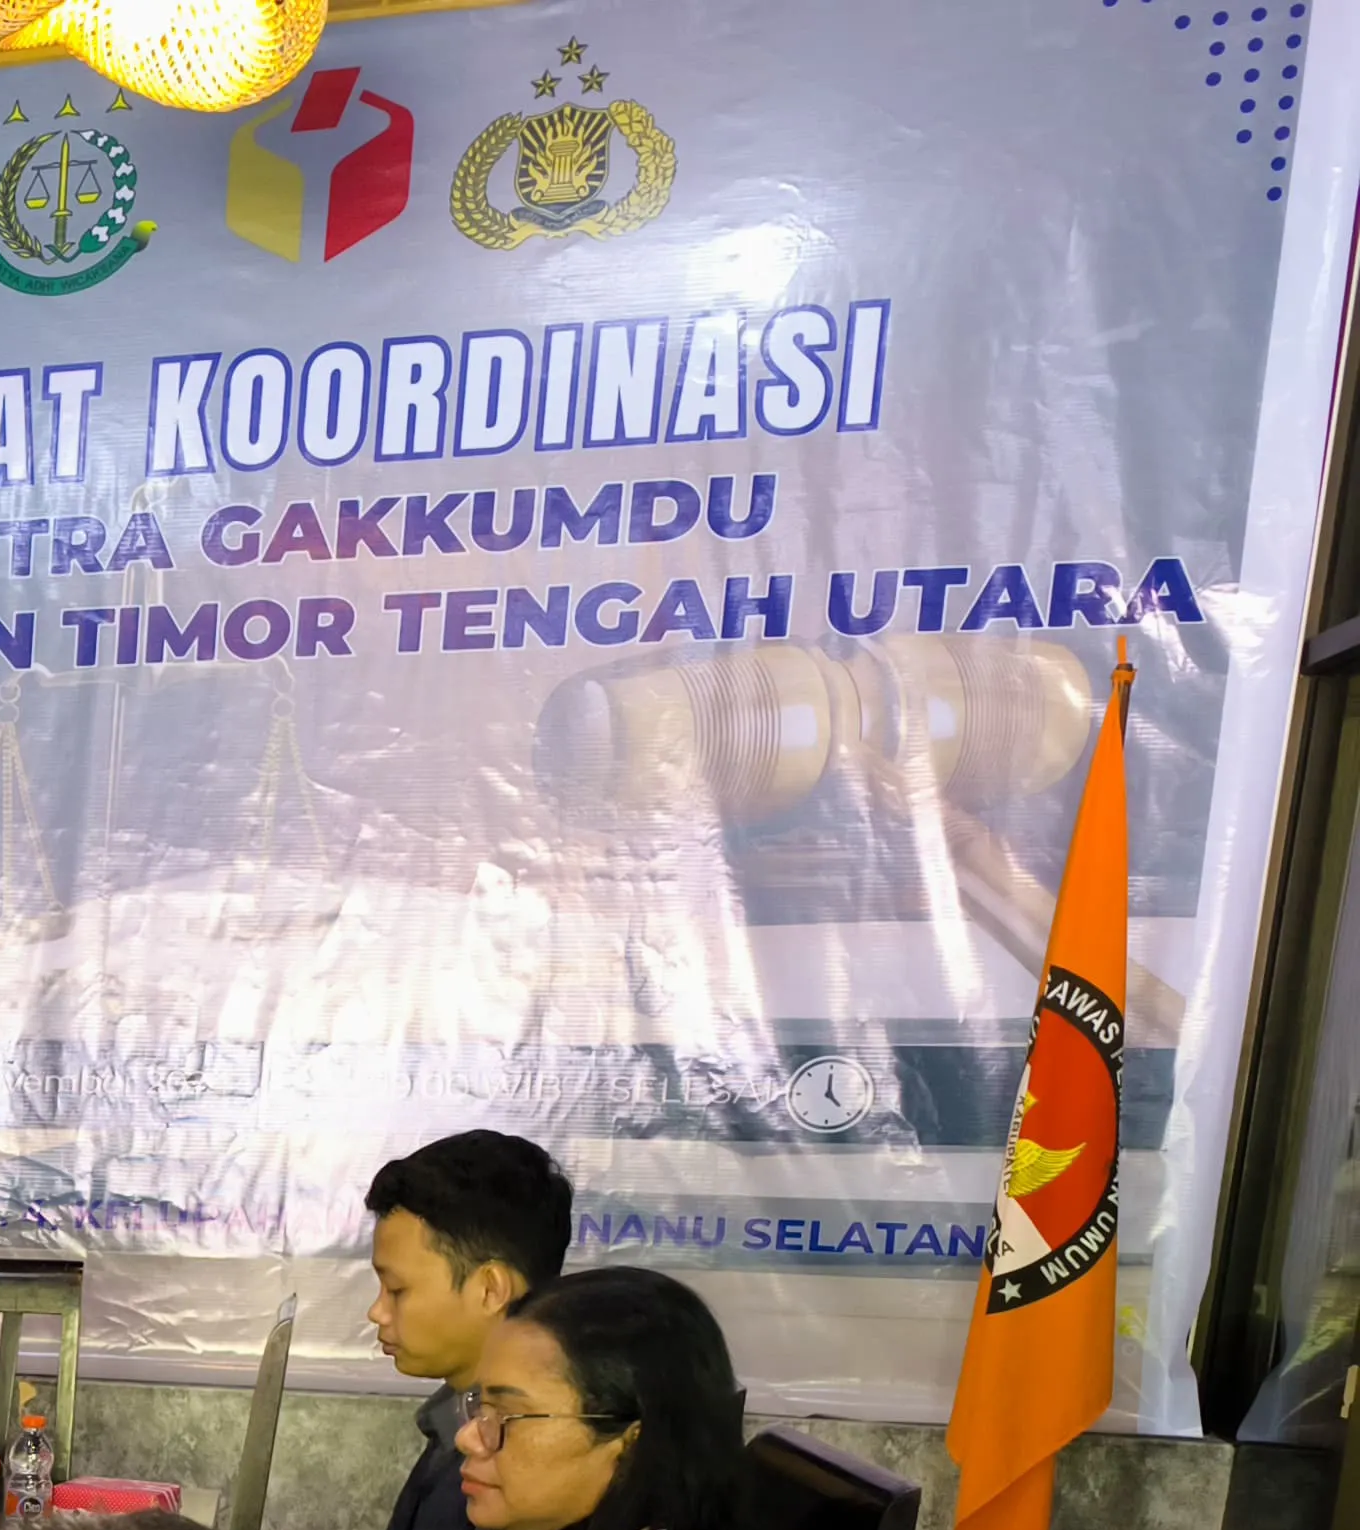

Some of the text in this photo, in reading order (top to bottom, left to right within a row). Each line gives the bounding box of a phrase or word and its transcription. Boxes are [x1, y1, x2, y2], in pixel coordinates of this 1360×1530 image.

[146, 299, 891, 477] KOORDINASI
[200, 473, 776, 569] GAKKUMDU
[61, 597, 356, 668] TIMOR
[383, 572, 797, 653] TENGAH
[826, 555, 1204, 637] UTARA
[1043, 972, 1120, 1044] AWAS
[742, 1217, 986, 1259] SELATAN
